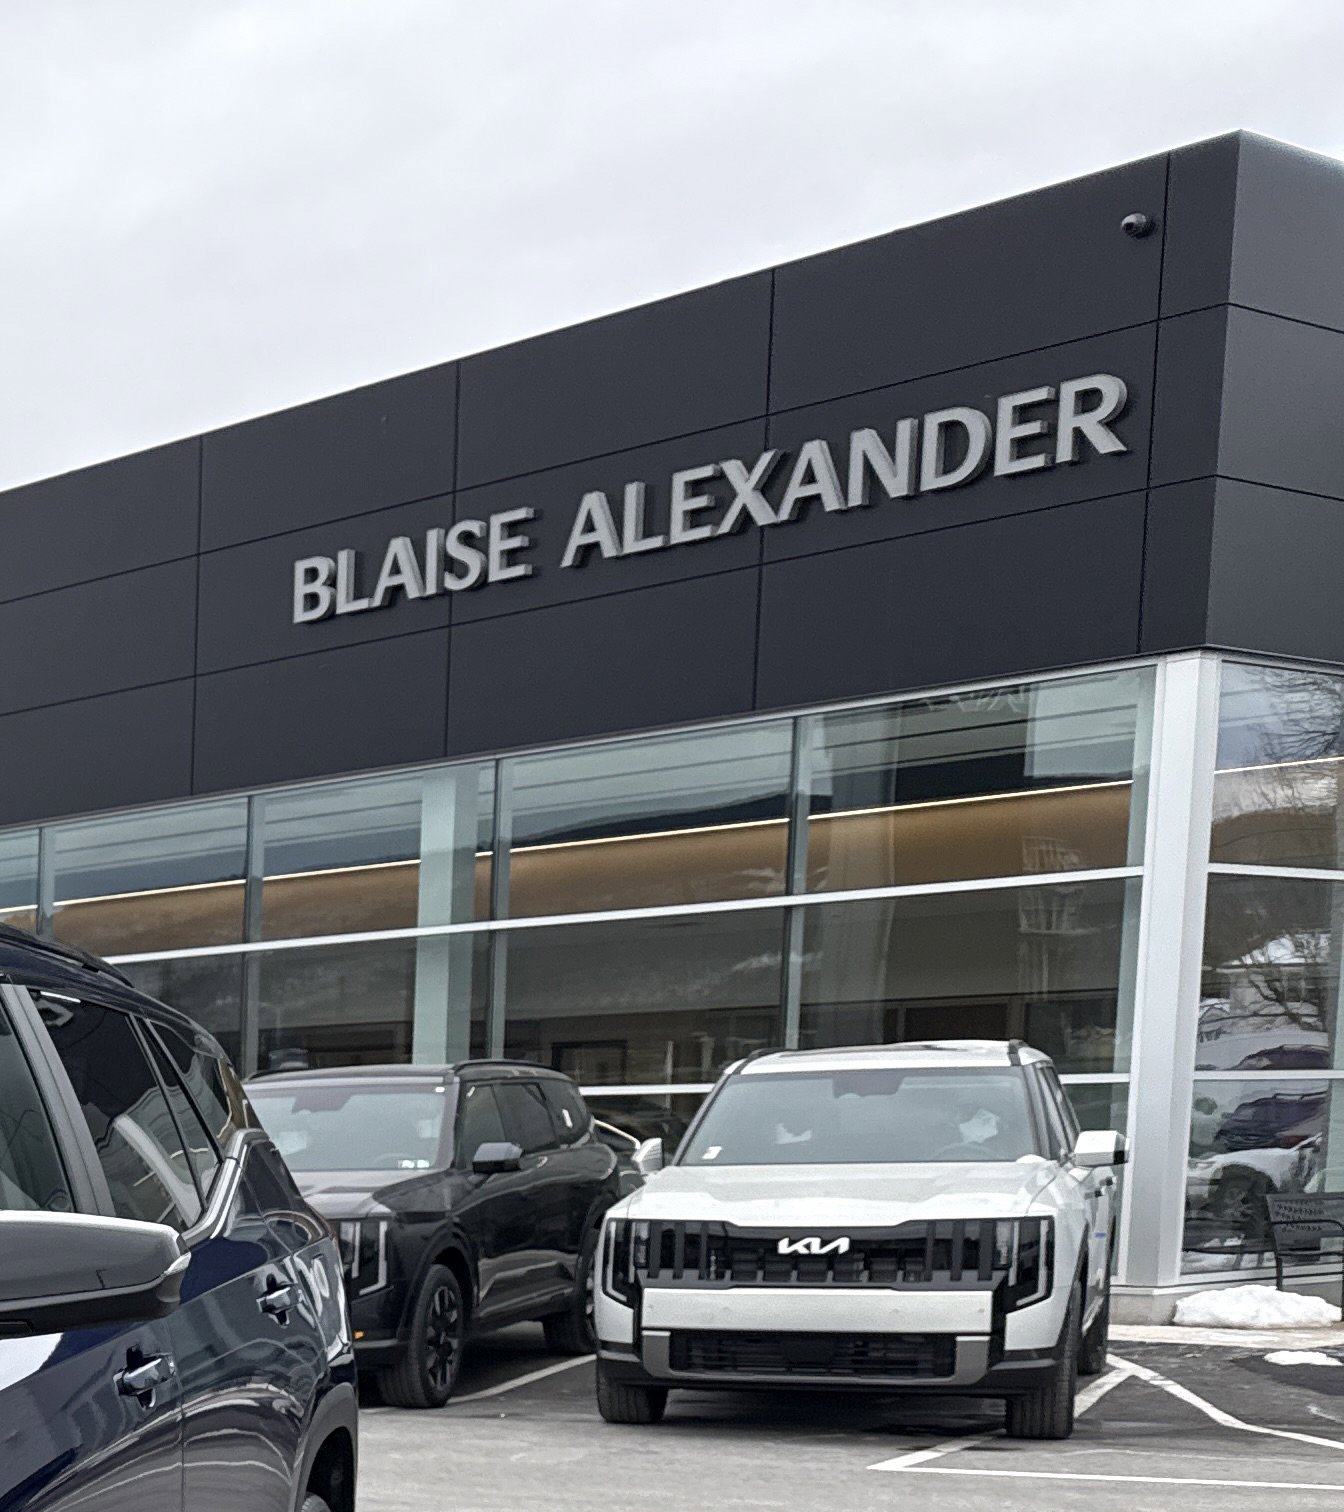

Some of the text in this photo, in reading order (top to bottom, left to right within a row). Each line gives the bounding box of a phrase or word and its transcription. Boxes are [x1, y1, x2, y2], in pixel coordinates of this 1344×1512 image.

[293, 373, 1128, 623] BLAISE ALEXANDER
[777, 1237, 850, 1255] KIA
